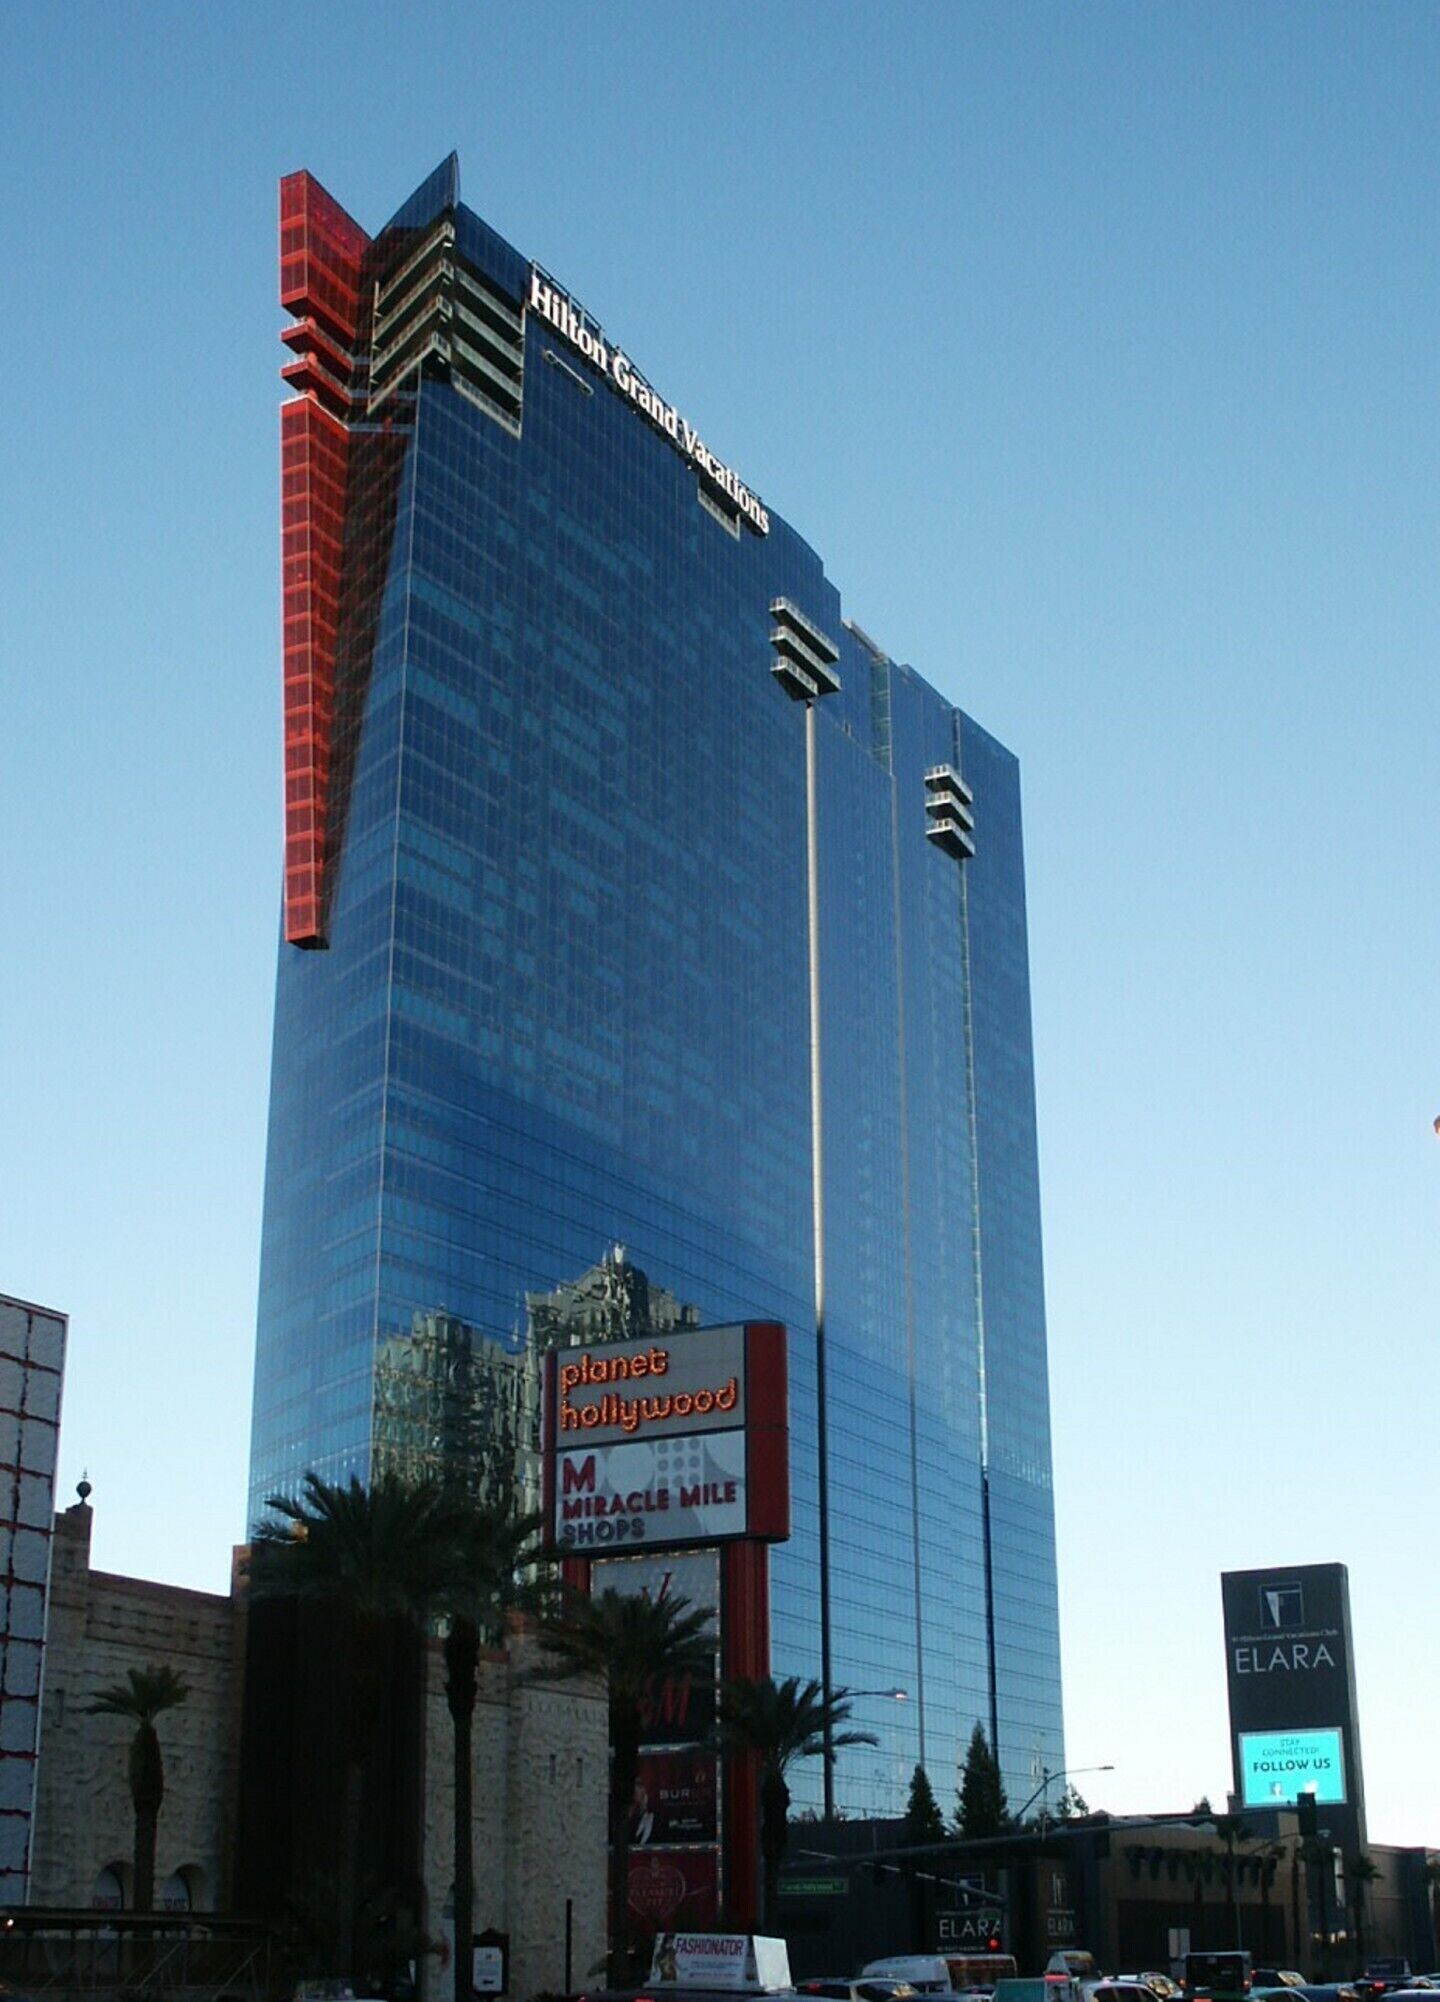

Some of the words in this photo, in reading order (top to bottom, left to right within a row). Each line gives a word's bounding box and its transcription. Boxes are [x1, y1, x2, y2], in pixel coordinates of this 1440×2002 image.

[531, 275, 608, 373] Hilton
[612, 351, 679, 438] Grand
[682, 418, 770, 534] Vacations
[561, 1347, 668, 1395] planet
[561, 1376, 737, 1432] hollywood
[563, 1455, 595, 1494] M
[563, 1489, 669, 1519] MIRACLE
[680, 1482, 736, 1507] MILE
[563, 1518, 645, 1545] SHOPS
[1235, 1643, 1336, 1674] ELARA
[1253, 1759, 1309, 1772] FOLLOW
[1313, 1758, 1331, 1769] US
